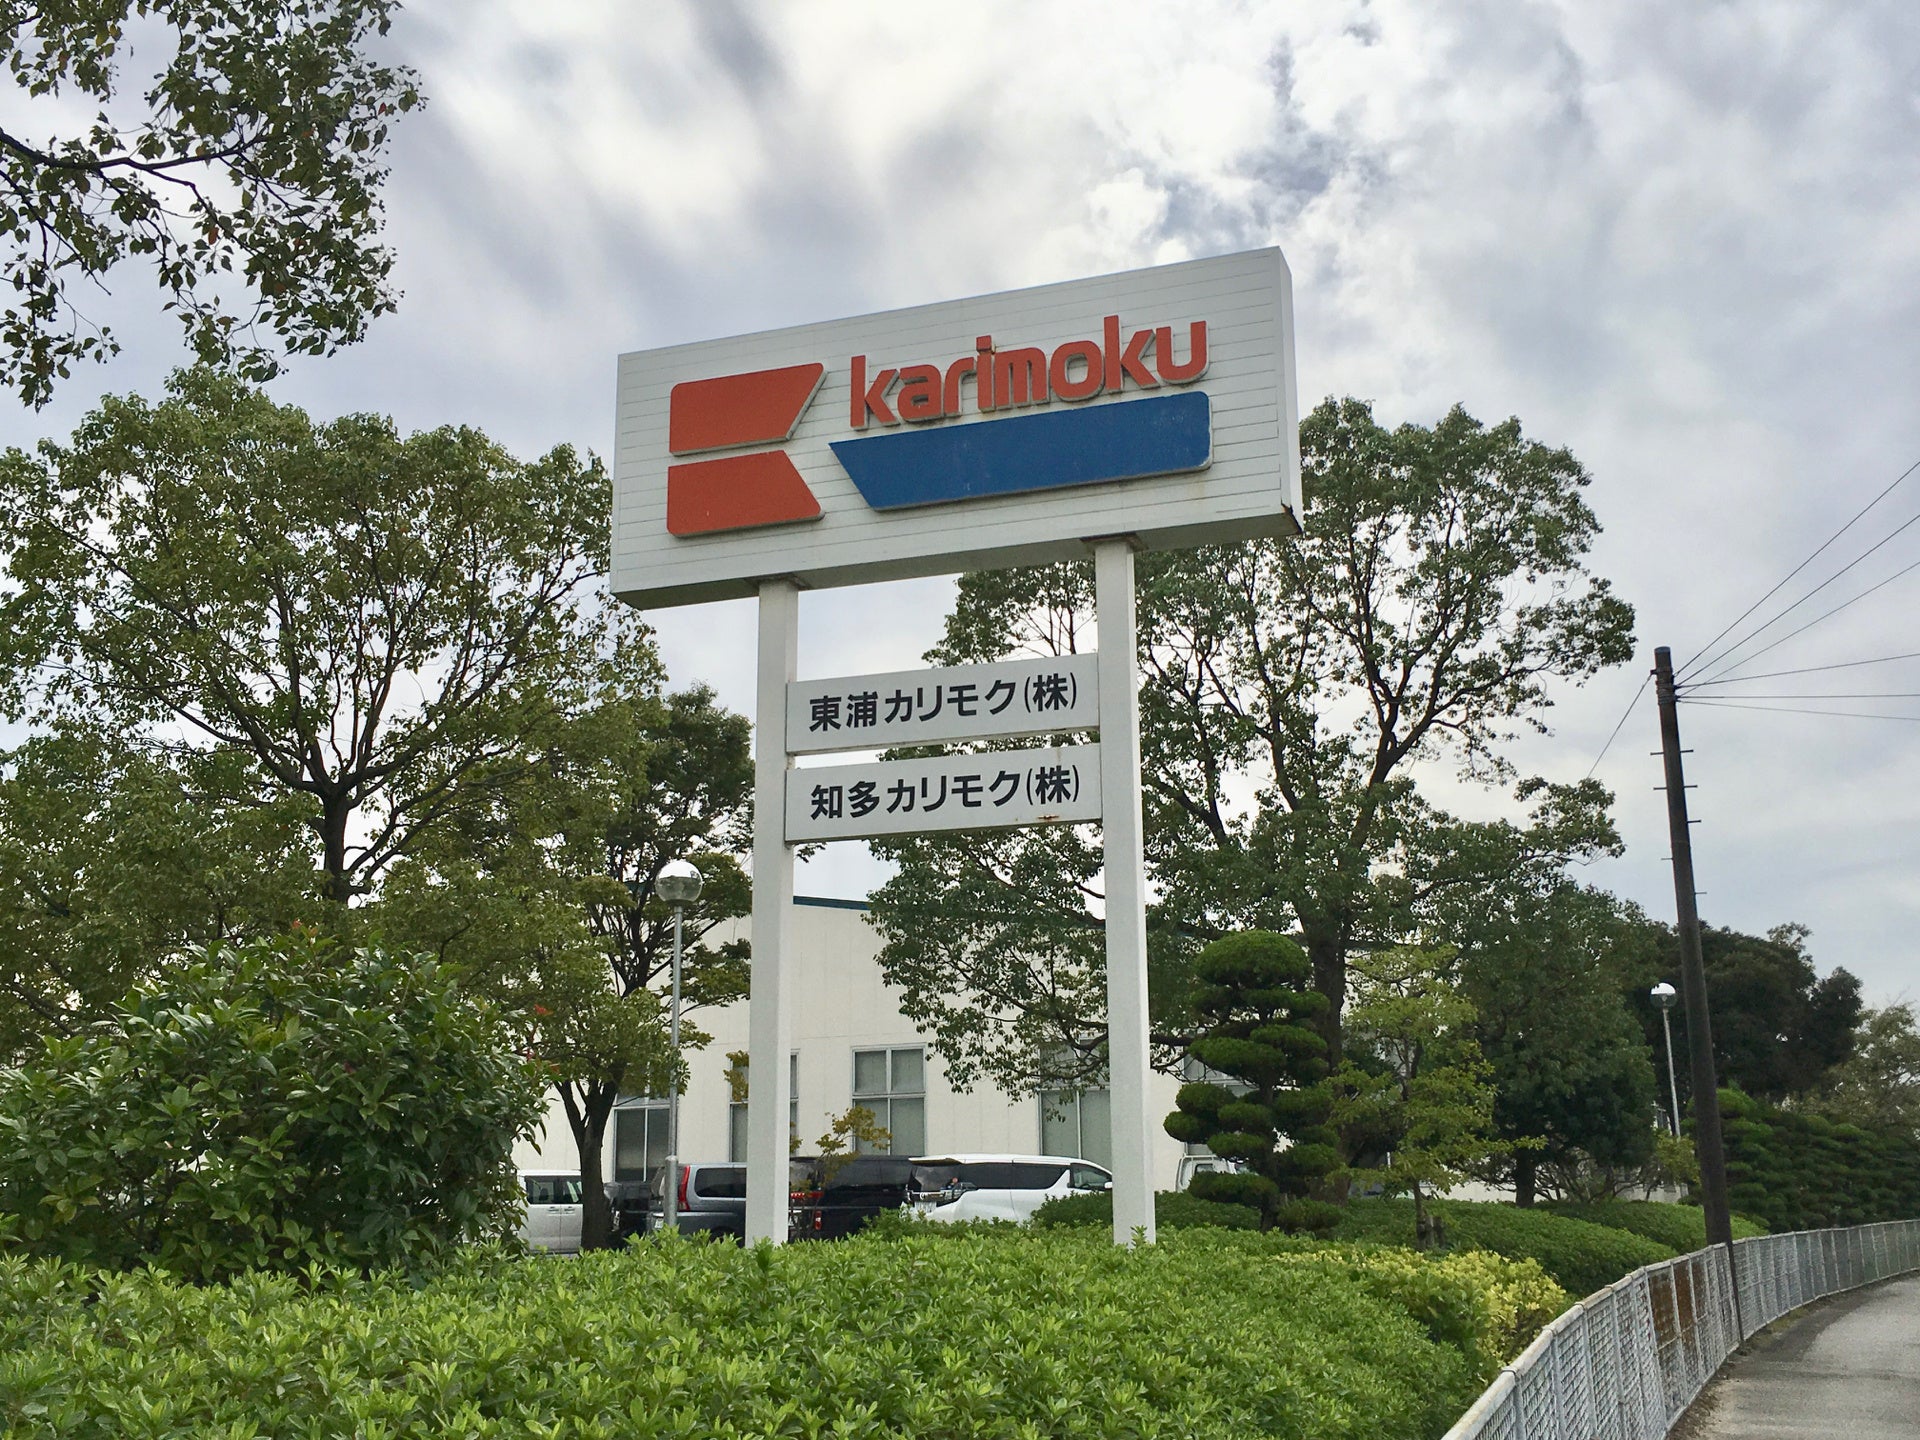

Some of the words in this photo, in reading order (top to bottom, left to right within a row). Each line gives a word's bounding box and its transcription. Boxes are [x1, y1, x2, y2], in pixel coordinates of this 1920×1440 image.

[850, 314, 1209, 430] karimoku
[809, 672, 1077, 732] 東浦カリモク(株)
[810, 765, 1080, 821] 知多カリモク(株)
